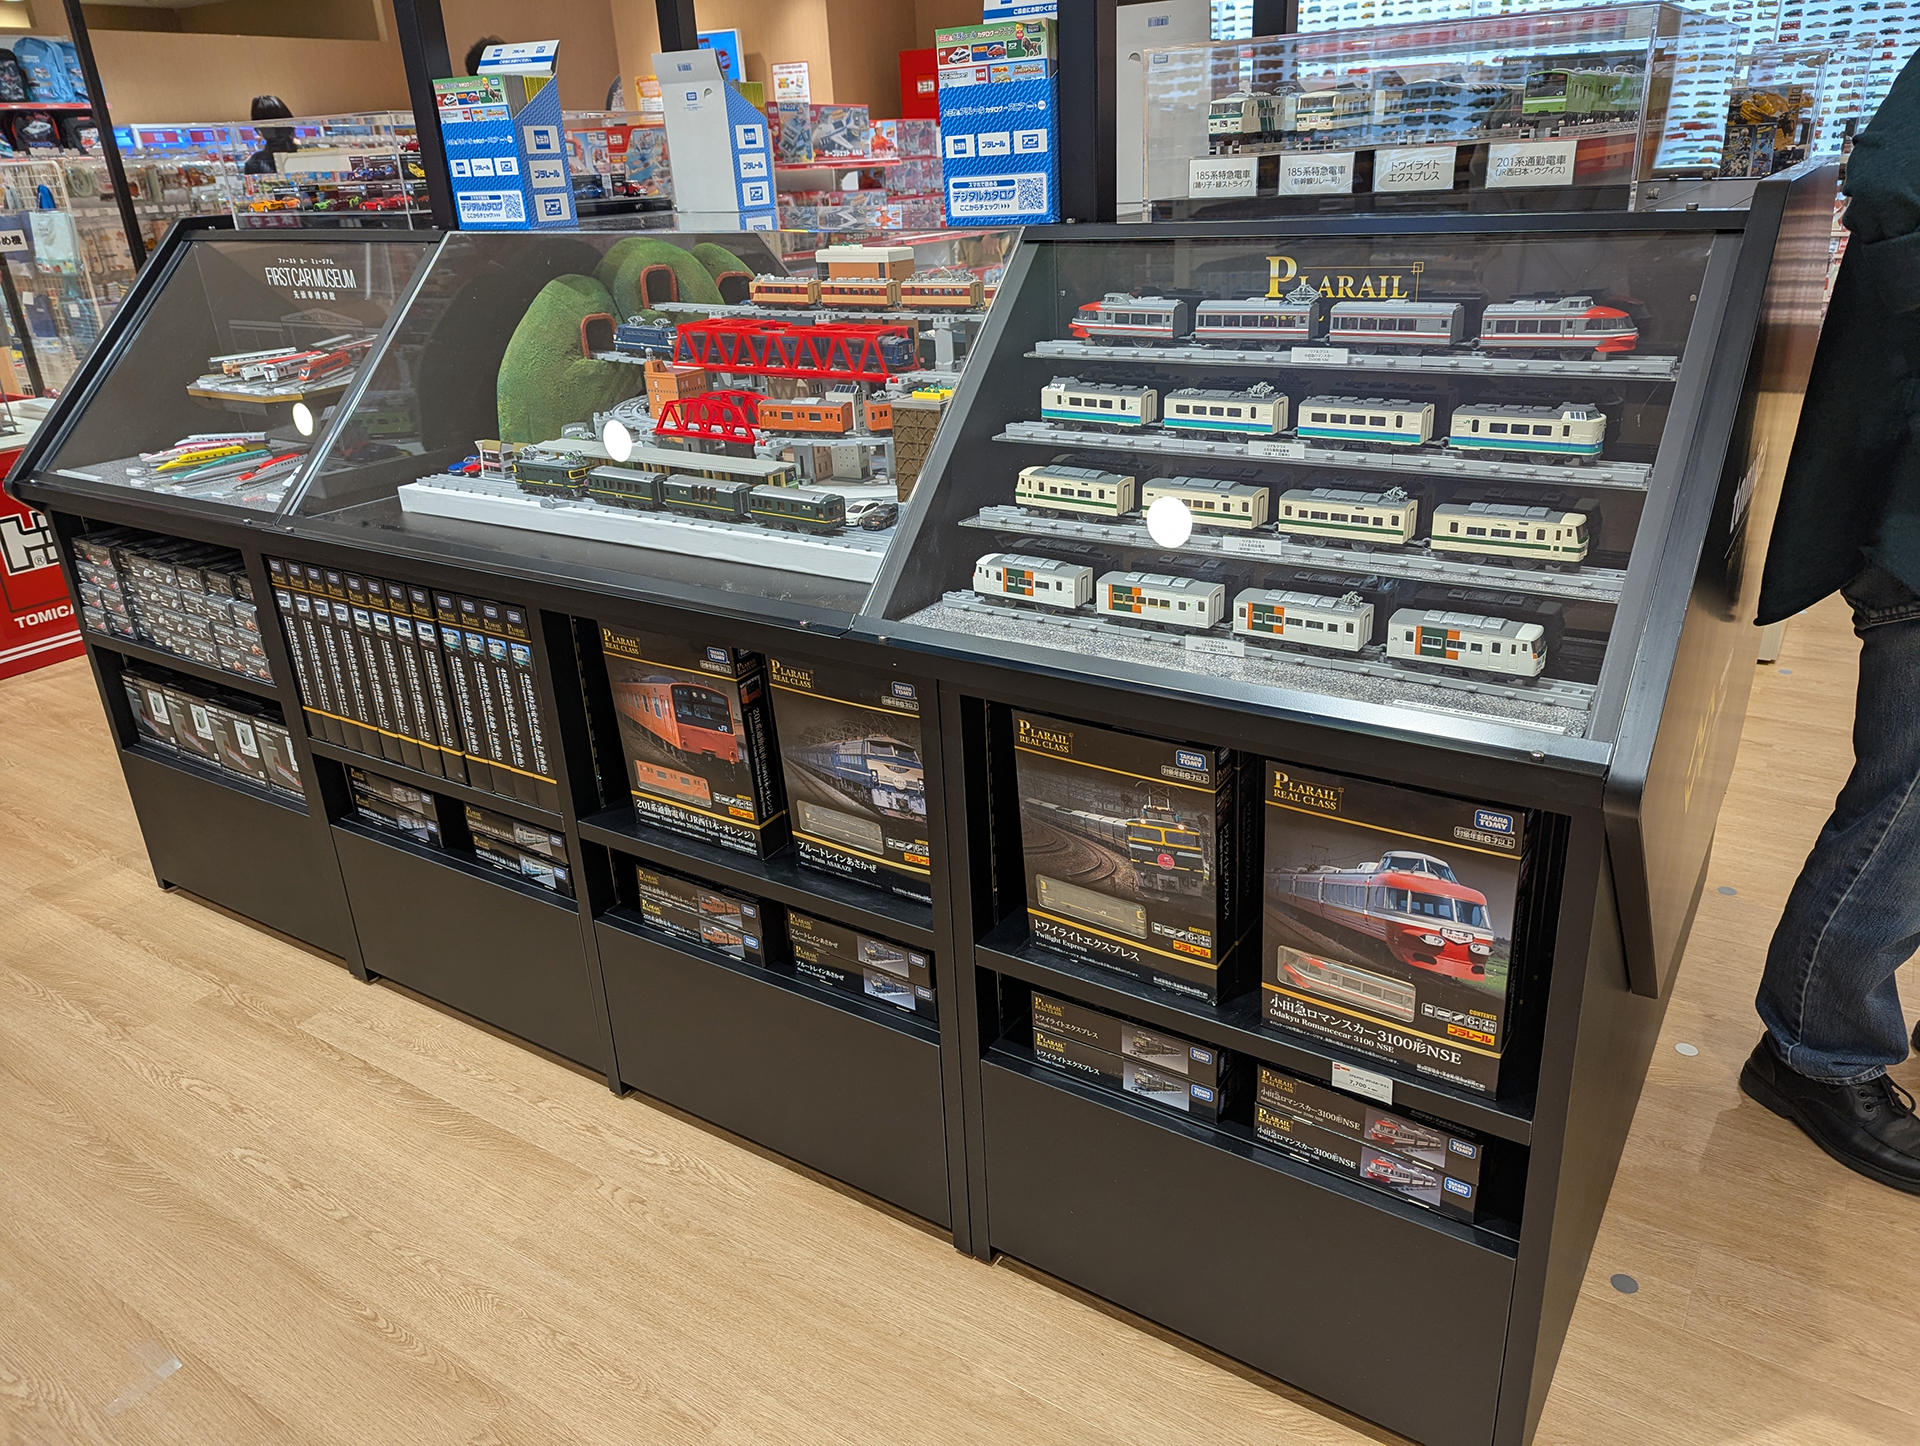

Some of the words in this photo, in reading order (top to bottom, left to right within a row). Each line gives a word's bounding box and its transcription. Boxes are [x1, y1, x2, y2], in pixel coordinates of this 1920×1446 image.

[981, 140, 1006, 149] プラレール
[1022, 136, 1038, 145] アニア
[743, 160, 763, 171] プラレール
[1390, 160, 1441, 172] トワイライト
[1496, 154, 1567, 169] 201系通勤電車
[534, 169, 560, 180] プラレール
[1195, 169, 1251, 181] 185系特急電車
[1286, 165, 1347, 178] 185系特急電車
[1388, 170, 1440, 183] エクスプレス
[1494, 165, 1566, 177] (JR西日本・ウグイス)
[1290, 175, 1341, 187] (新幹線リレー号)
[952, 188, 1016, 203] デジタルカタログ
[460, 201, 503, 212] デジタルカタログ
[545, 200, 560, 210] アニア
[0, 234, 23, 246] め機
[264, 267, 293, 287] FIRST
[291, 267, 312, 288] CAR
[311, 268, 357, 289] MUSEUM
[602, 628, 639, 648] PLARAIL
[769, 658, 812, 681] PLARAIL
[772, 673, 790, 685] REAL
[790, 677, 812, 689] CLASS
[894, 689, 913, 697] TOMY
[717, 724, 729, 733] JR
[1018, 719, 1069, 745] PLARAIL
[1019, 735, 1041, 748] REAL
[1040, 740, 1069, 753] CLASS
[1179, 752, 1202, 762] TAKARA
[1179, 758, 1203, 768] TOMY
[1273, 770, 1338, 801] PLARAIL
[1273, 789, 1301, 803] REAL
[1302, 795, 1338, 811] CLASS
[636, 799, 756, 841] 201系通勤電車(JR西日本・オレンジ)
[1479, 813, 1508, 824] TAKARA
[1479, 819, 1508, 831] TOMY
[797, 841, 877, 874] ブルートレインあさかぜ
[790, 928, 839, 949] ブルートレインあさかぜ
[1034, 919, 1140, 962] トワイライトエクスプレス
[1035, 930, 1061, 947] Twilight
[1062, 936, 1088, 953] Express
[1174, 941, 1210, 958] プラレール
[796, 959, 845, 981] ブルートレインあさかぜ
[1034, 997, 1063, 1013] PLARAIL
[1469, 1009, 1497, 1021] CONTENTS
[1034, 1013, 1098, 1039] トワイライトエクスプレス
[1269, 1008, 1300, 1023] Odakyu
[1301, 1018, 1352, 1040] Romancecar
[1353, 1034, 1375, 1047] 3100
[1376, 1041, 1395, 1054] NSE
[1270, 993, 1462, 1066] 小田急ロマンスカー3100形NSE
[1036, 1033, 1065, 1049] PLARAIL
[1448, 1025, 1492, 1044] プラレール
[1036, 1049, 1100, 1076] トワイライトエクスプレス
[1261, 1069, 1294, 1089] PLARAIL
[1349, 1079, 1367, 1090] 7,700
[1260, 1086, 1361, 1132] 小田急ロマンスカー3100形NSE
[1257, 1107, 1291, 1127] PLARAIL
[1257, 1124, 1357, 1170] 小田急ロマンスカー3100形NSE
[1451, 1140, 1474, 1151] TAKARA
[1451, 1145, 1473, 1156] TOMY
[1446, 1184, 1469, 1195] TOMY
[1447, 1179, 1469, 1190] TAKARA
